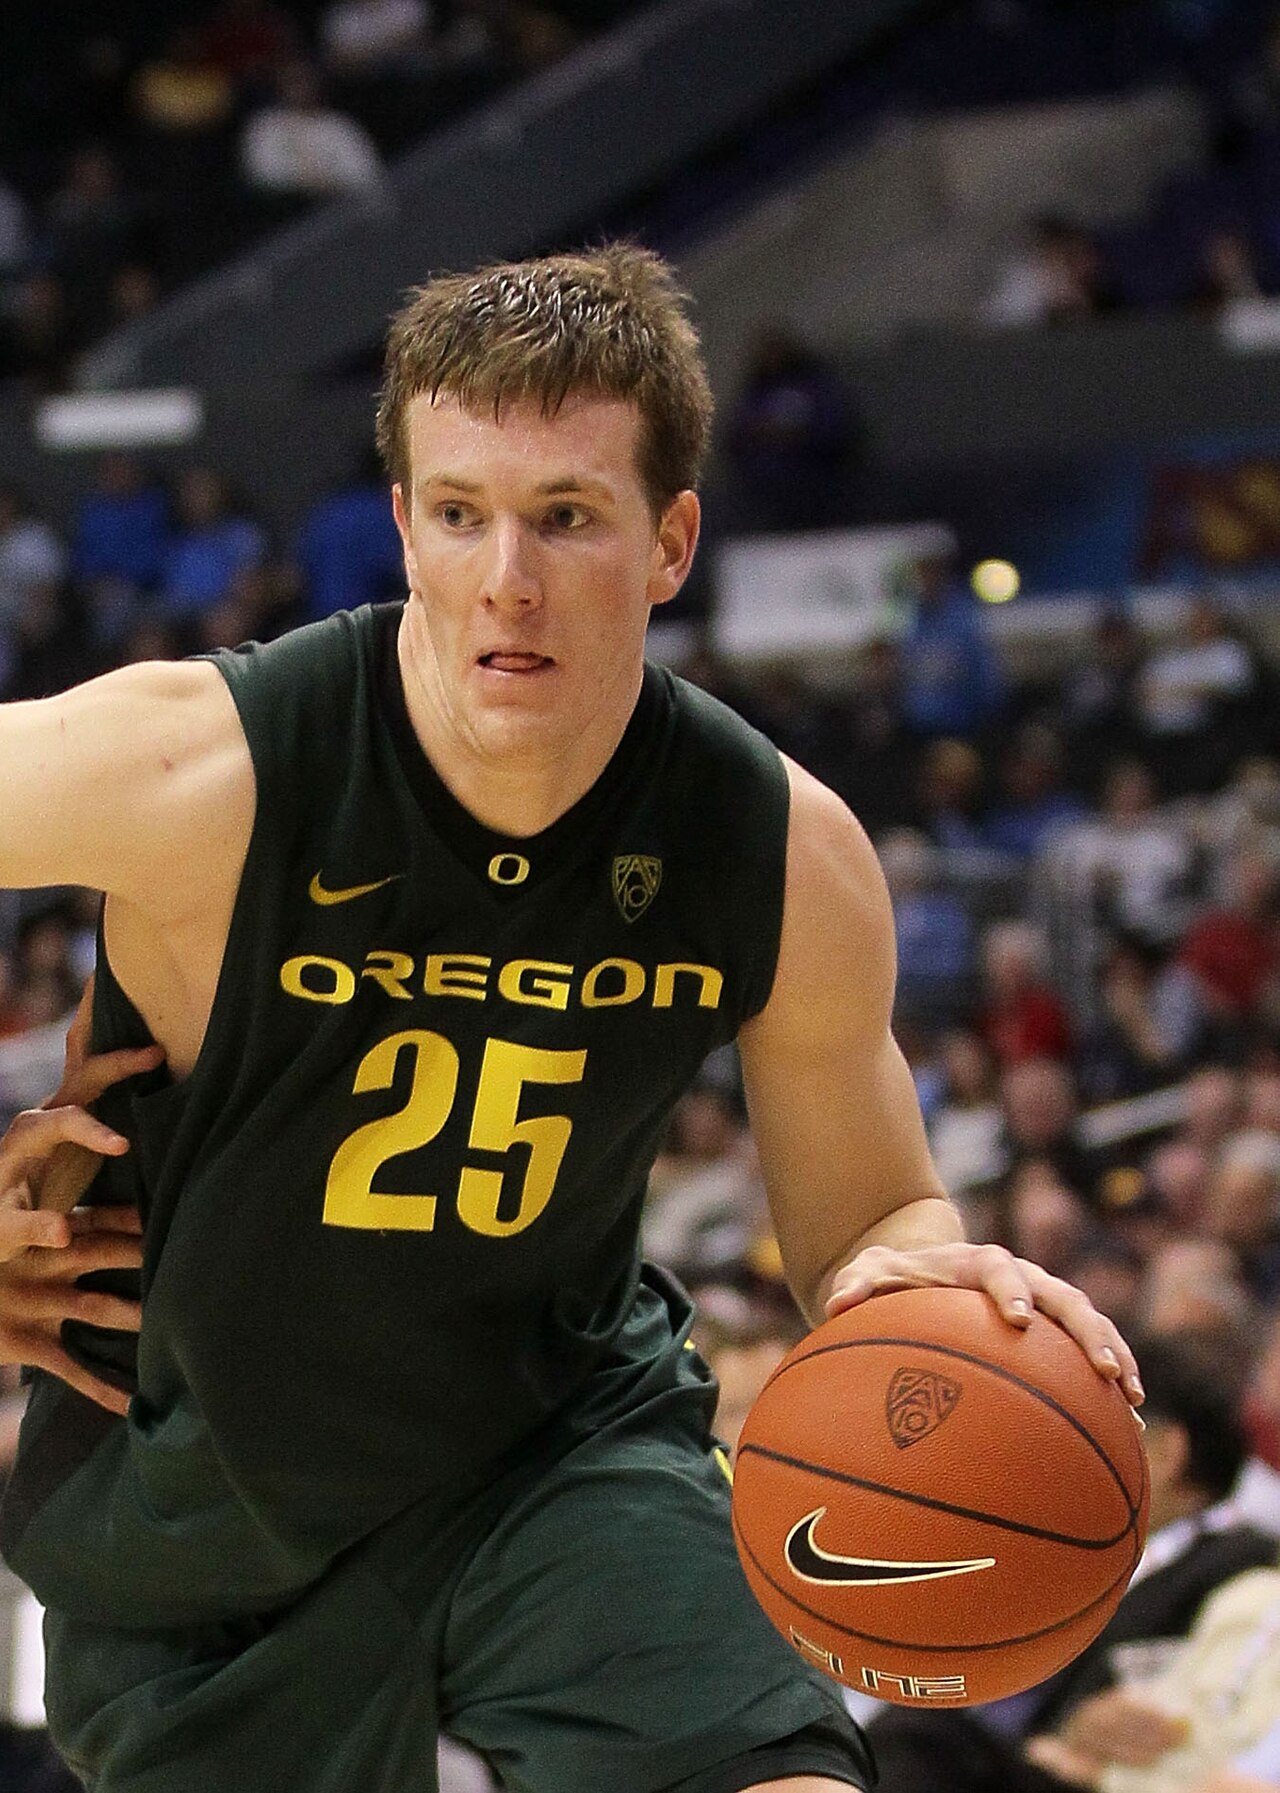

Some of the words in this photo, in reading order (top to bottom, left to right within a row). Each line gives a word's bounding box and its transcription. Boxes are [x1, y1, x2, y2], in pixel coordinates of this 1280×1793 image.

[487, 852, 531, 886] O
[279, 949, 725, 1012] OREGON
[322, 1028, 588, 1238] 25
